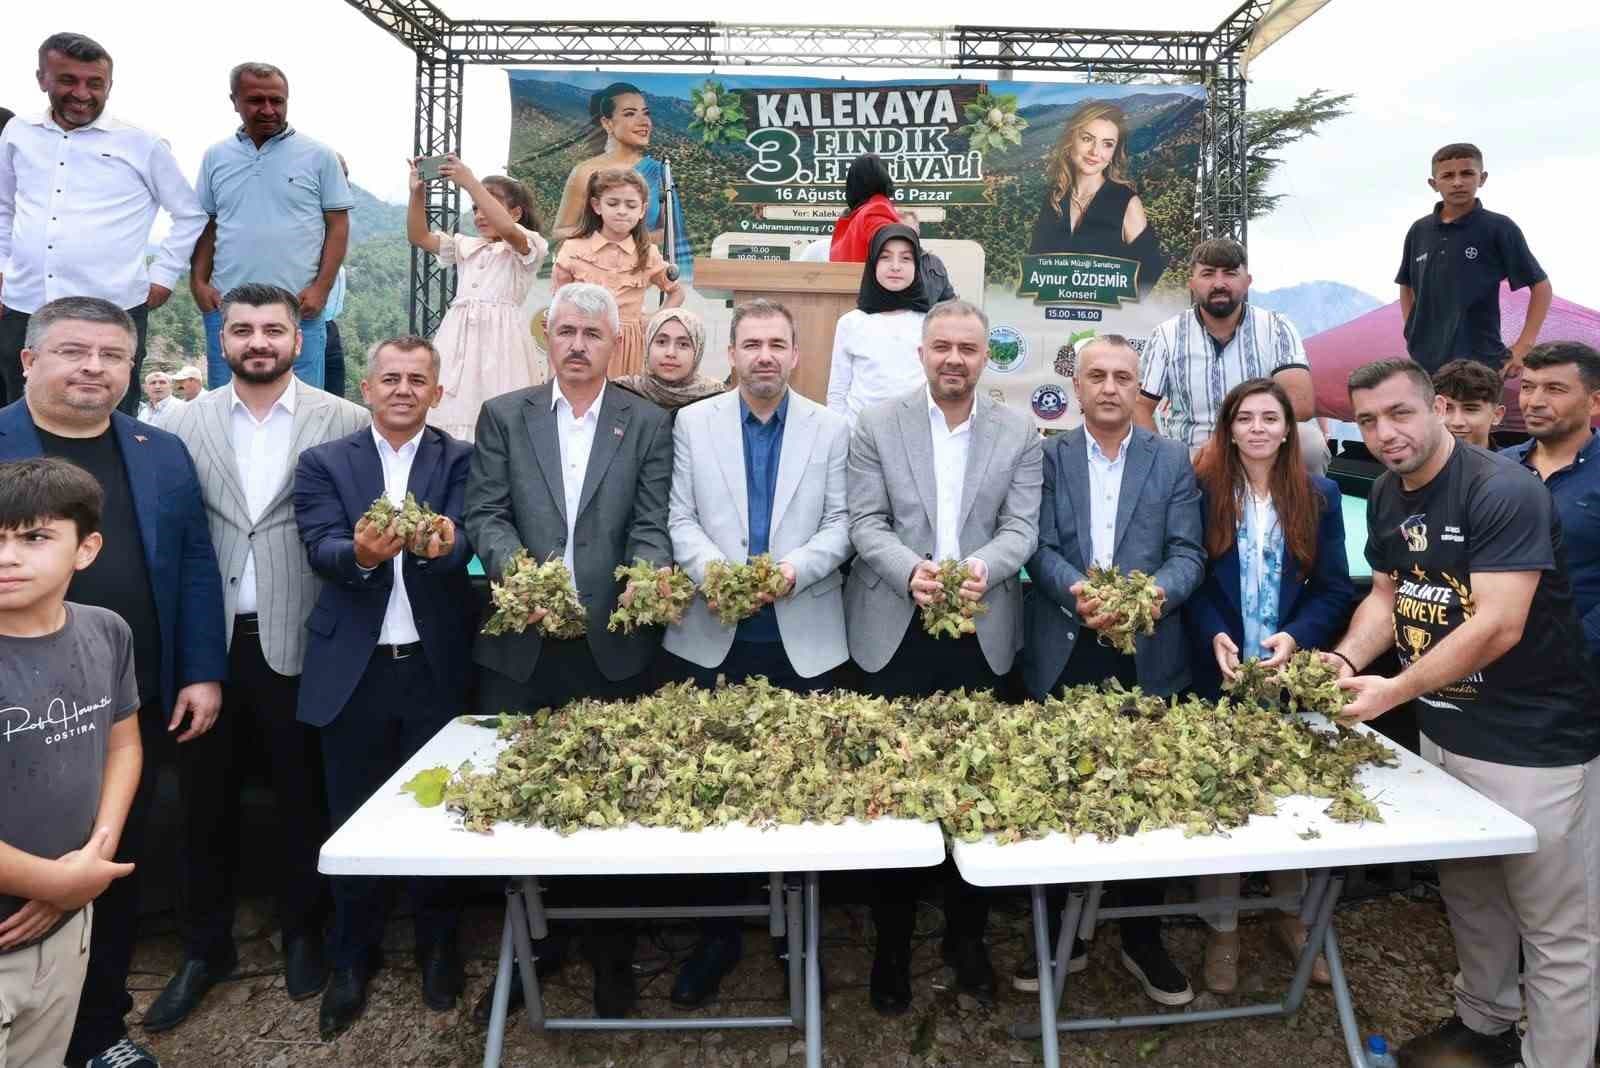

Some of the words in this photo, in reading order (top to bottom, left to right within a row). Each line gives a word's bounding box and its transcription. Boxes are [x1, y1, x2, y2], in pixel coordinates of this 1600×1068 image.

[757, 89, 958, 127] KALEKAYA
[813, 127, 949, 156] FINDIK
[776, 189, 792, 201] 16
[909, 189, 953, 201] Pazar
[751, 222, 819, 233] Kahramanmaraş
[1039, 258, 1053, 266] Türk
[1054, 258, 1069, 266] Halk
[1030, 271, 1068, 287] Aynur
[1071, 269, 1128, 288] ÖZDEMİR
[1058, 288, 1097, 300] Konseri
[1047, 309, 1070, 318] 15.00
[1077, 310, 1099, 319] 16.00
[45, 722, 96, 744] COSTIRA
